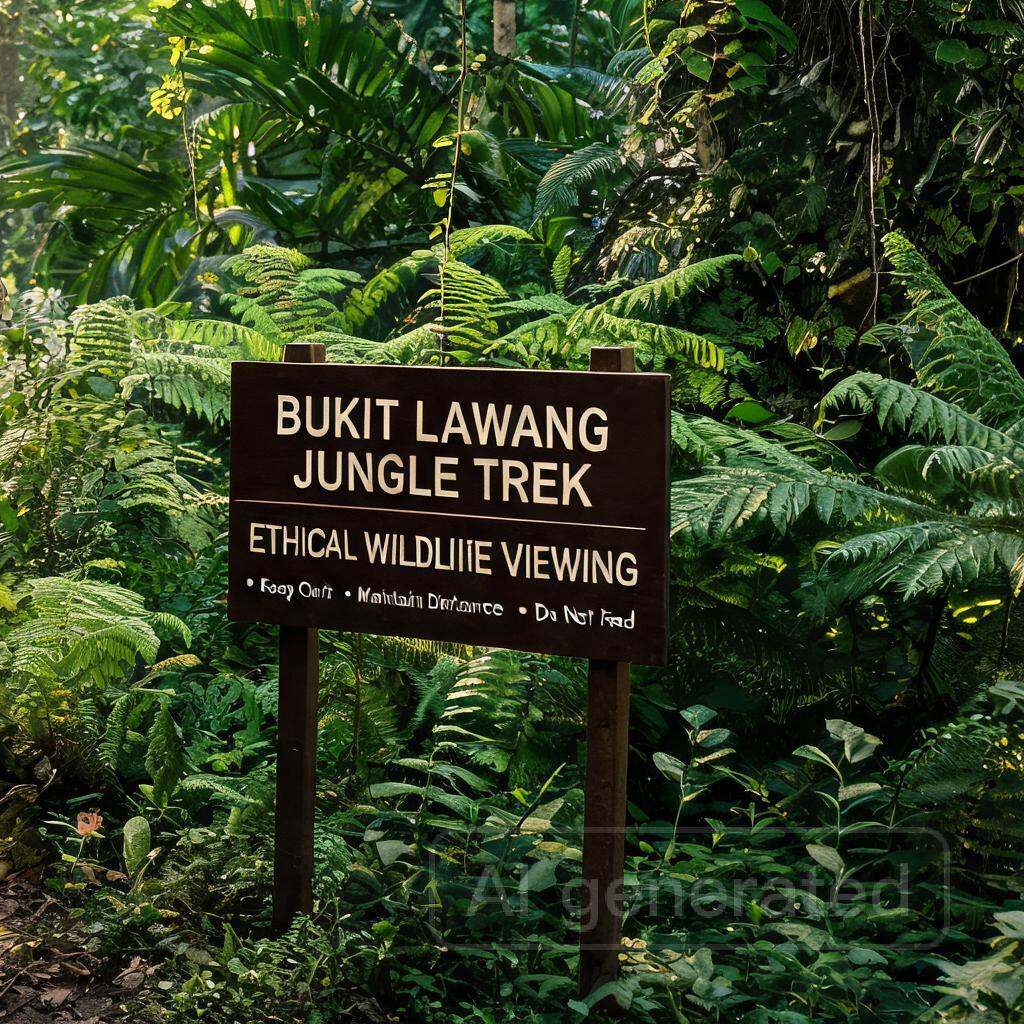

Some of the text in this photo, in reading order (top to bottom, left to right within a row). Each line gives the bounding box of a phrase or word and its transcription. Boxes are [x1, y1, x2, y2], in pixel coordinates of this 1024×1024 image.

[276, 394, 609, 453] BUKIT LAWANG
[293, 449, 593, 508] JUNGLE TREK
[249, 522, 358, 561] ETHICAL
[500, 541, 639, 587] VIEWING
